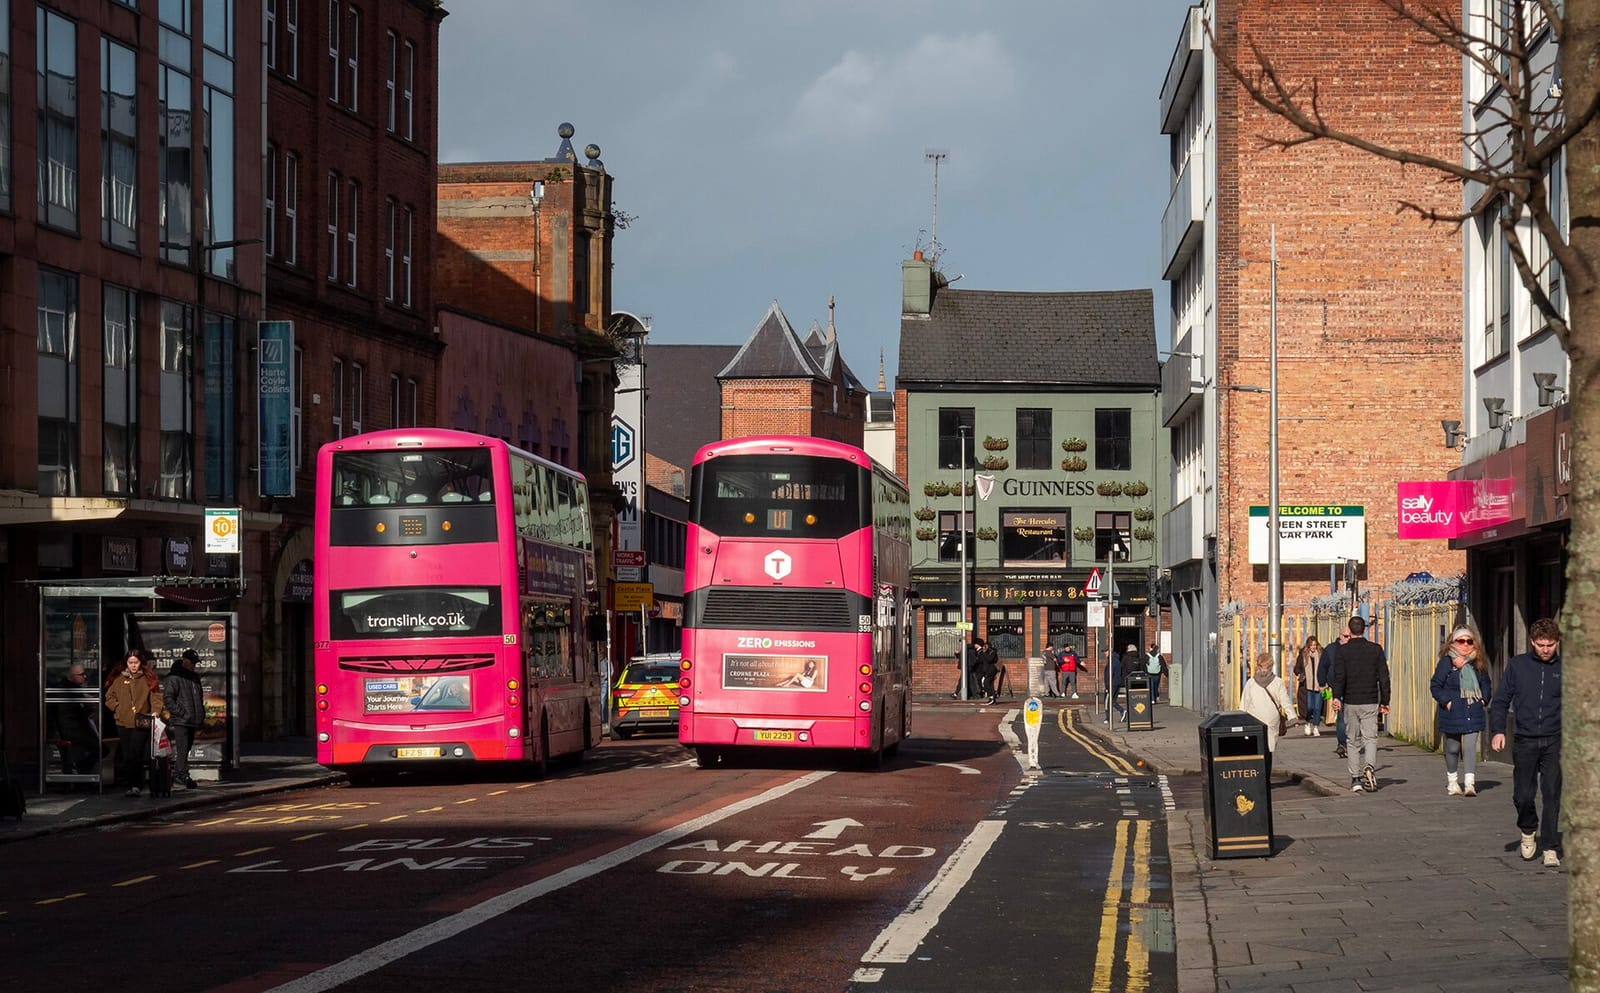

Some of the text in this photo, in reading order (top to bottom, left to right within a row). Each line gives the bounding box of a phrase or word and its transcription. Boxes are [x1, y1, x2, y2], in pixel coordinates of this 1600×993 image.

[260, 368, 286, 377] Harte
[260, 376, 286, 386] Coyle
[260, 385, 290, 394] Collins
[1003, 479, 1095, 496] GUINNESS
[1401, 494, 1434, 512] sally
[1278, 507, 1342, 515] ELCOME TO
[773, 511, 787, 528] U1
[1013, 517, 1057, 526] The Hercules
[1401, 510, 1453, 526] beauty
[215, 522, 229, 533] 10
[1306, 521, 1347, 529] STREET
[1016, 528, 1053, 538] Restaurant
[1280, 531, 1334, 539] CAR PARK
[771, 558, 785, 574] T
[977, 586, 1089, 600] THE HERCULES BA
[368, 613, 466, 628] translink.co.uk
[505, 635, 515, 643] 50
[737, 637, 816, 648] ZERO EMISSIONS
[152, 649, 172, 658] The
[730, 659, 739, 667] It's
[368, 683, 383, 691] USED
[383, 695, 409, 703] Journey
[367, 703, 386, 711] Starts
[773, 732, 792, 740] 2293
[1222, 769, 1257, 779] LITTER
[338, 836, 554, 852] BUS
[667, 839, 937, 859] AHEAD
[226, 855, 526, 873] LANE
[655, 860, 897, 882] ONLY
